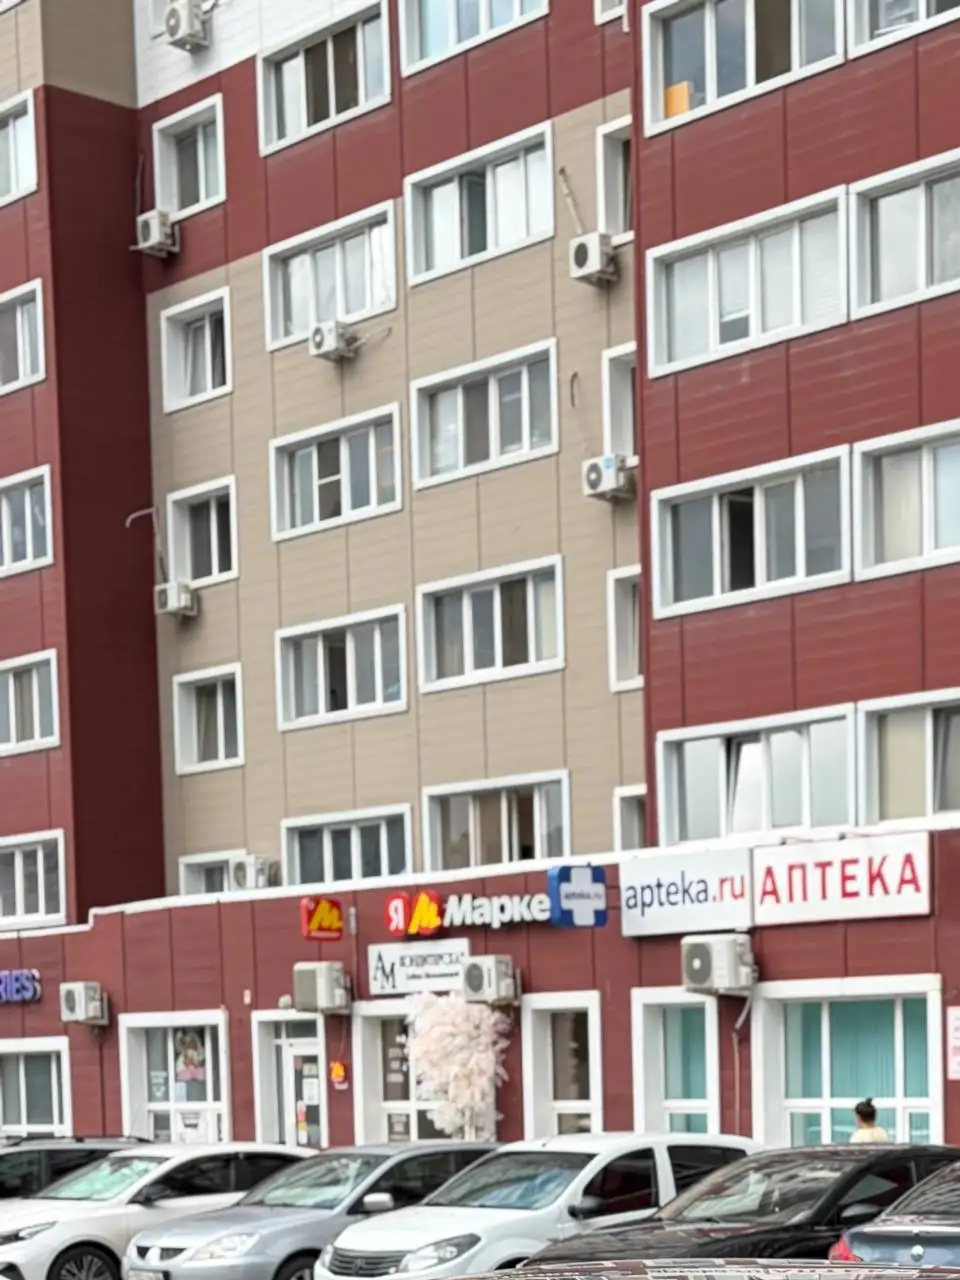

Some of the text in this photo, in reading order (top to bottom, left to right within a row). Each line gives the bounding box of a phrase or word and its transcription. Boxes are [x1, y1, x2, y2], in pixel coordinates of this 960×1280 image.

[625, 870, 745, 916] apteka.ru
[760, 853, 922, 905] АПТЕКА
[443, 893, 551, 930] Марке
